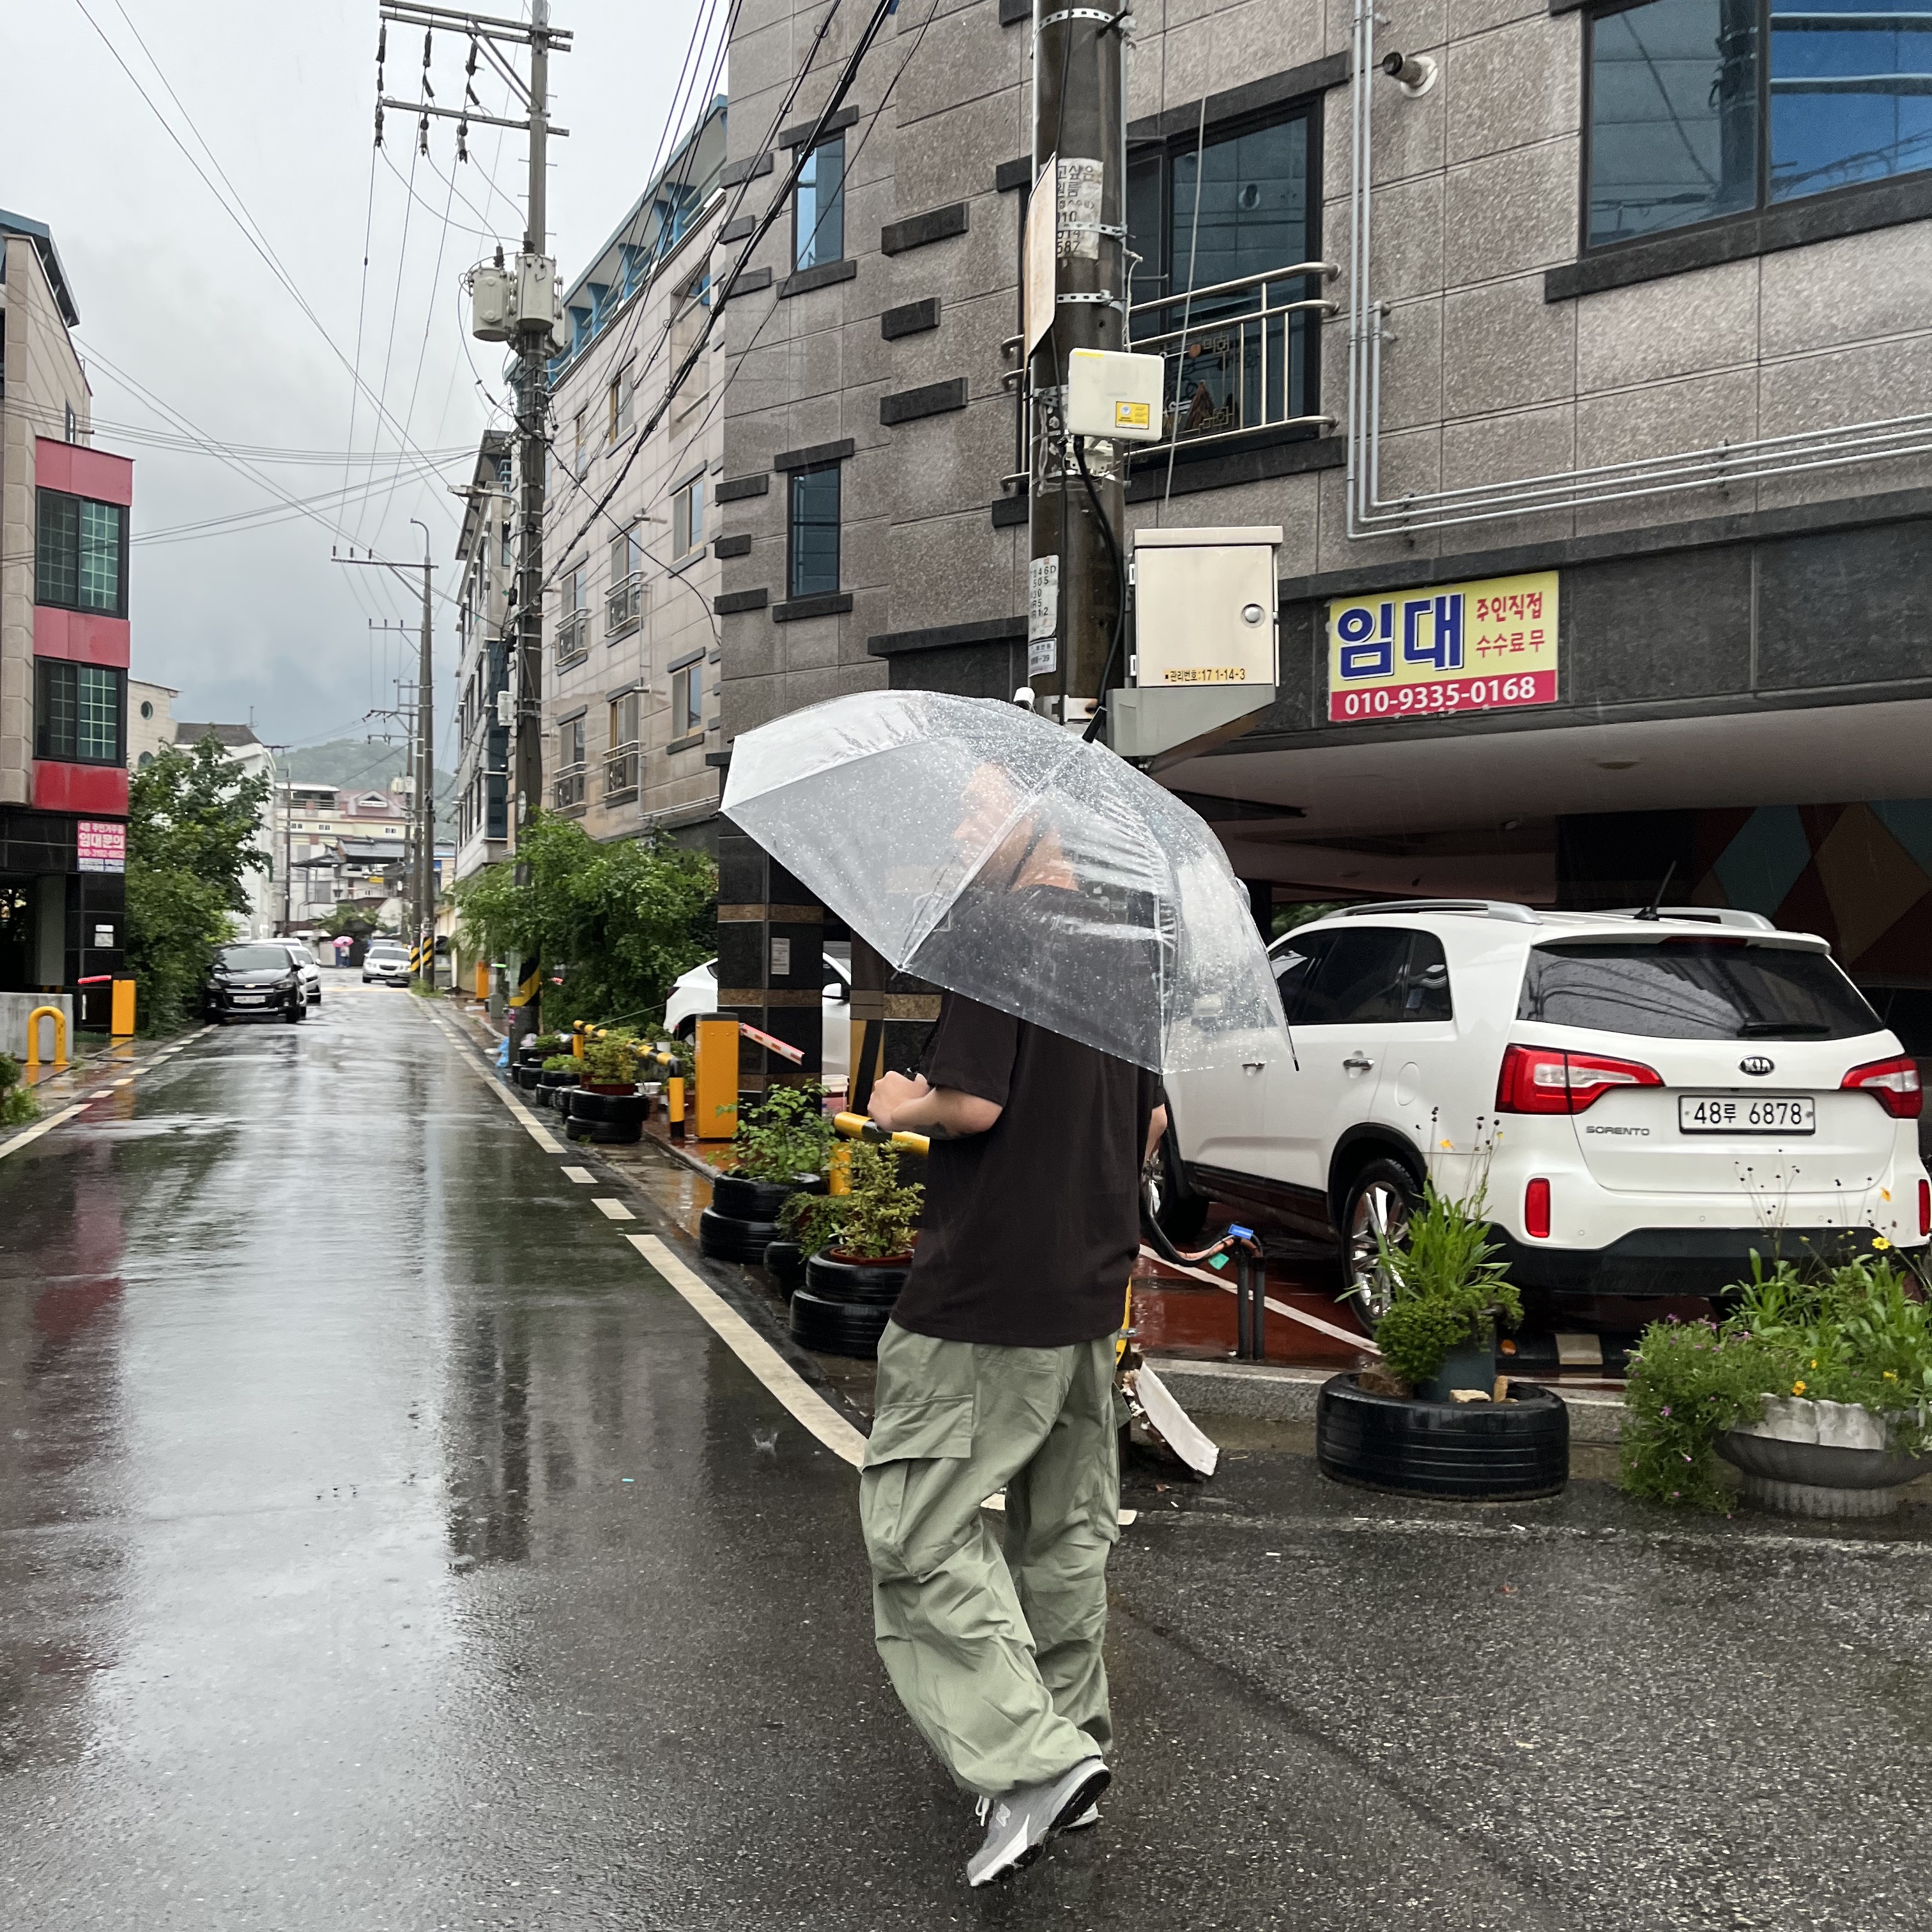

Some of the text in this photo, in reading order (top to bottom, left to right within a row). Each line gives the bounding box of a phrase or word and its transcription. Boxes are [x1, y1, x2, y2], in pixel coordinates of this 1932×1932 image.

[1476, 592, 1542, 623] 주인직접
[1337, 593, 1465, 680] 임대
[1344, 676, 1536, 715] 010-9335-0168
[79, 832, 125, 849] 임대문의
[1744, 1059, 1770, 1071] KIA
[1749, 1102, 1802, 1124] 6878
[1586, 1126, 1650, 1136] SORENTO
